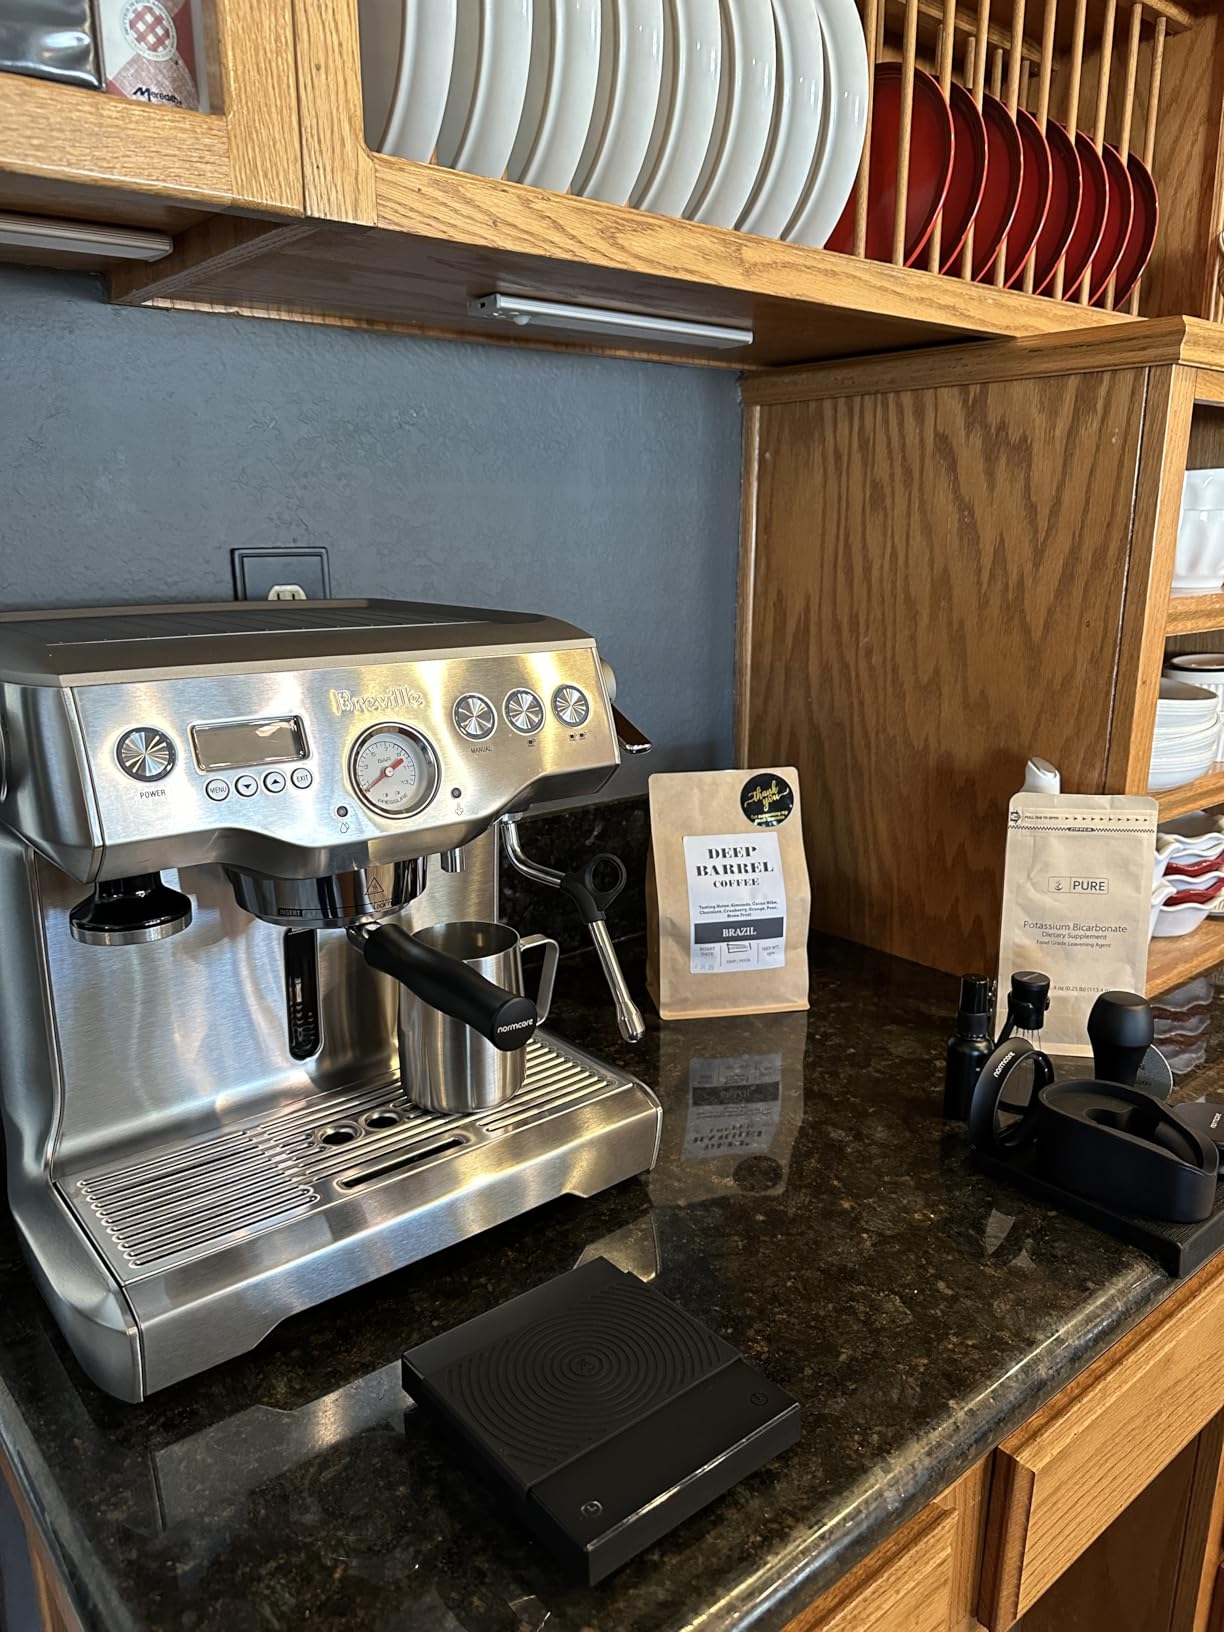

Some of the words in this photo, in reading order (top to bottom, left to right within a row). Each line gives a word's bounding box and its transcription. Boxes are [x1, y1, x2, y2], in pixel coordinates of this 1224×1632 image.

[333, 687, 424, 713] Breville
[470, 745, 493, 754] MANUAL
[296, 774, 309, 783] EXIT
[139, 789, 166, 799] POWER
[209, 786, 227, 794] MENU
[707, 846, 757, 859] DEEP
[696, 862, 774, 876] BARREL
[713, 878, 760, 888] COFFEE
[1072, 880, 1105, 891] PURE
[1023, 920, 1070, 931] Potassium
[1072, 924, 1127, 933] Bicarbonate
[722, 927, 756, 937] BRAZIL
[1041, 931, 1065, 939] Dietary
[1067, 932, 1107, 940] Supplement
[497, 1018, 534, 1034] normcore
[993, 1051, 1016, 1078] normcore
